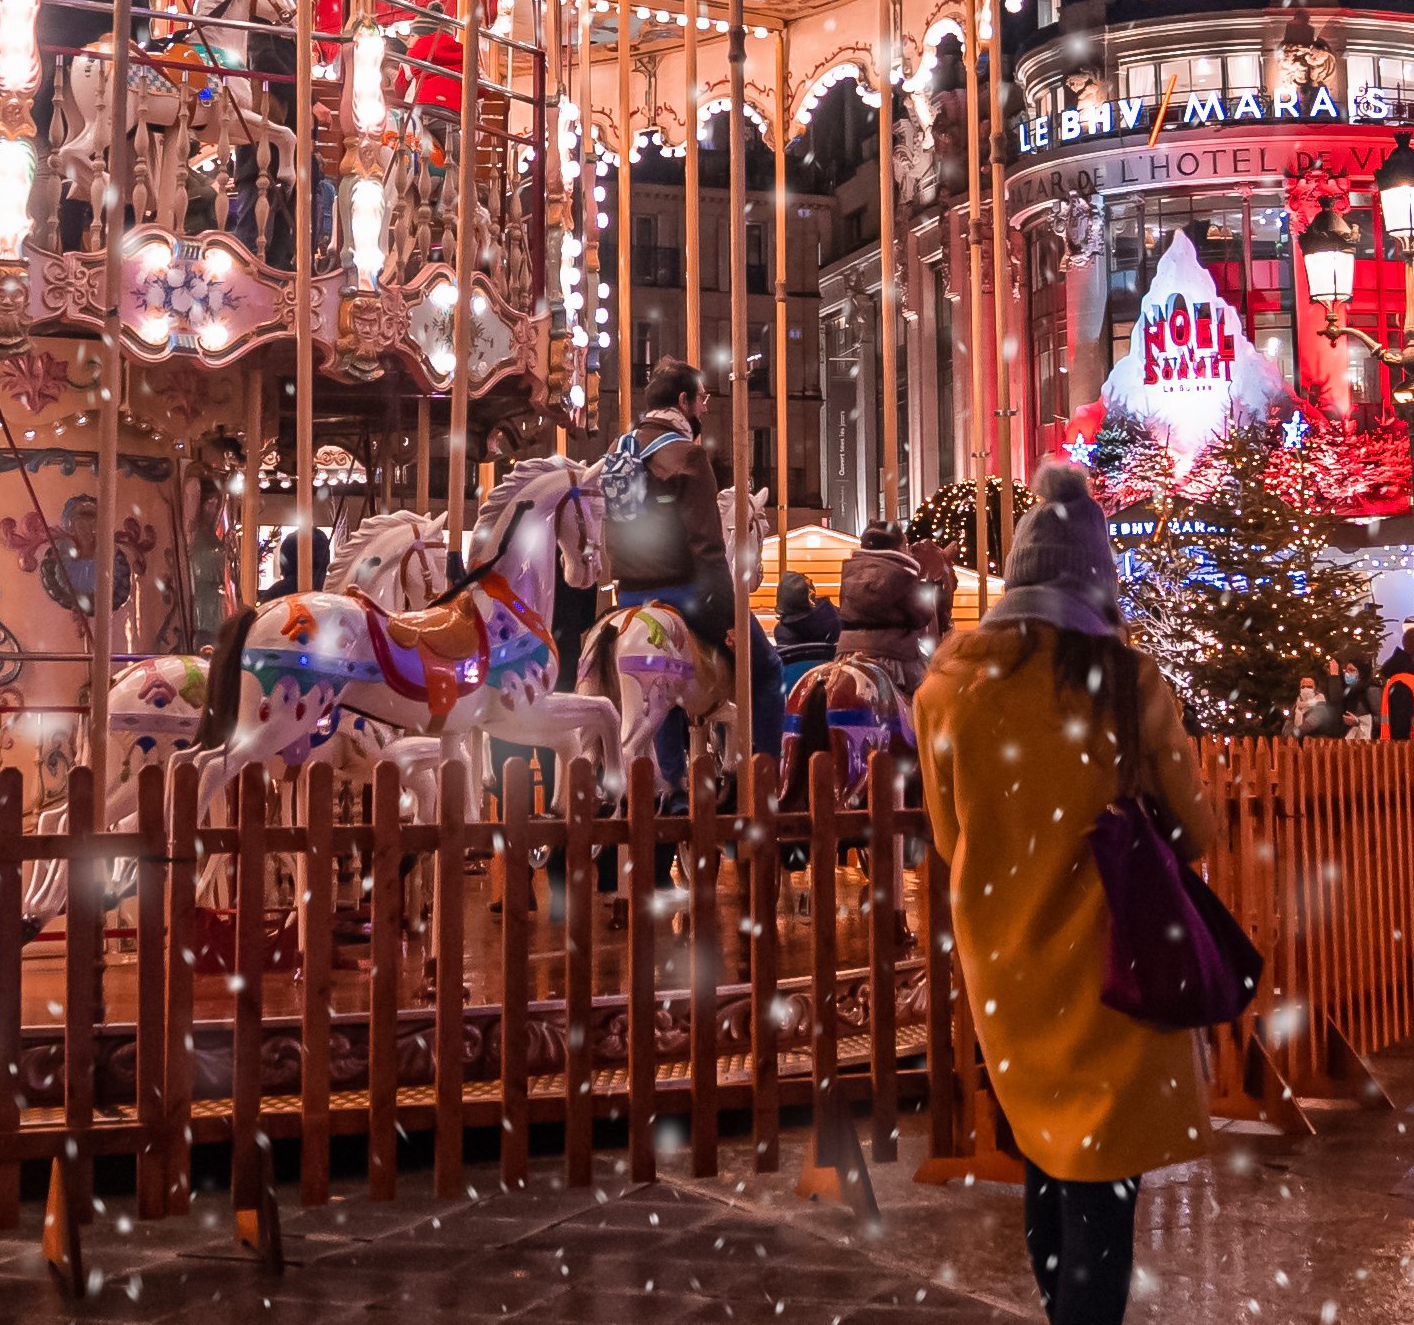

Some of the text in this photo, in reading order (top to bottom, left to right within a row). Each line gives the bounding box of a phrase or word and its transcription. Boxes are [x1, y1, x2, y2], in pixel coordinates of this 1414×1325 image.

[1019, 116, 1050, 153] LE
[1061, 98, 1144, 142] BHV
[1184, 85, 1388, 124] MARAIS
[1010, 170, 1066, 206] AZAR
[1077, 167, 1105, 191] DE
[1120, 147, 1278, 184] L'HOTEL
[1296, 150, 1332, 172] DE
[838, 453, 846, 476] Ouvert
